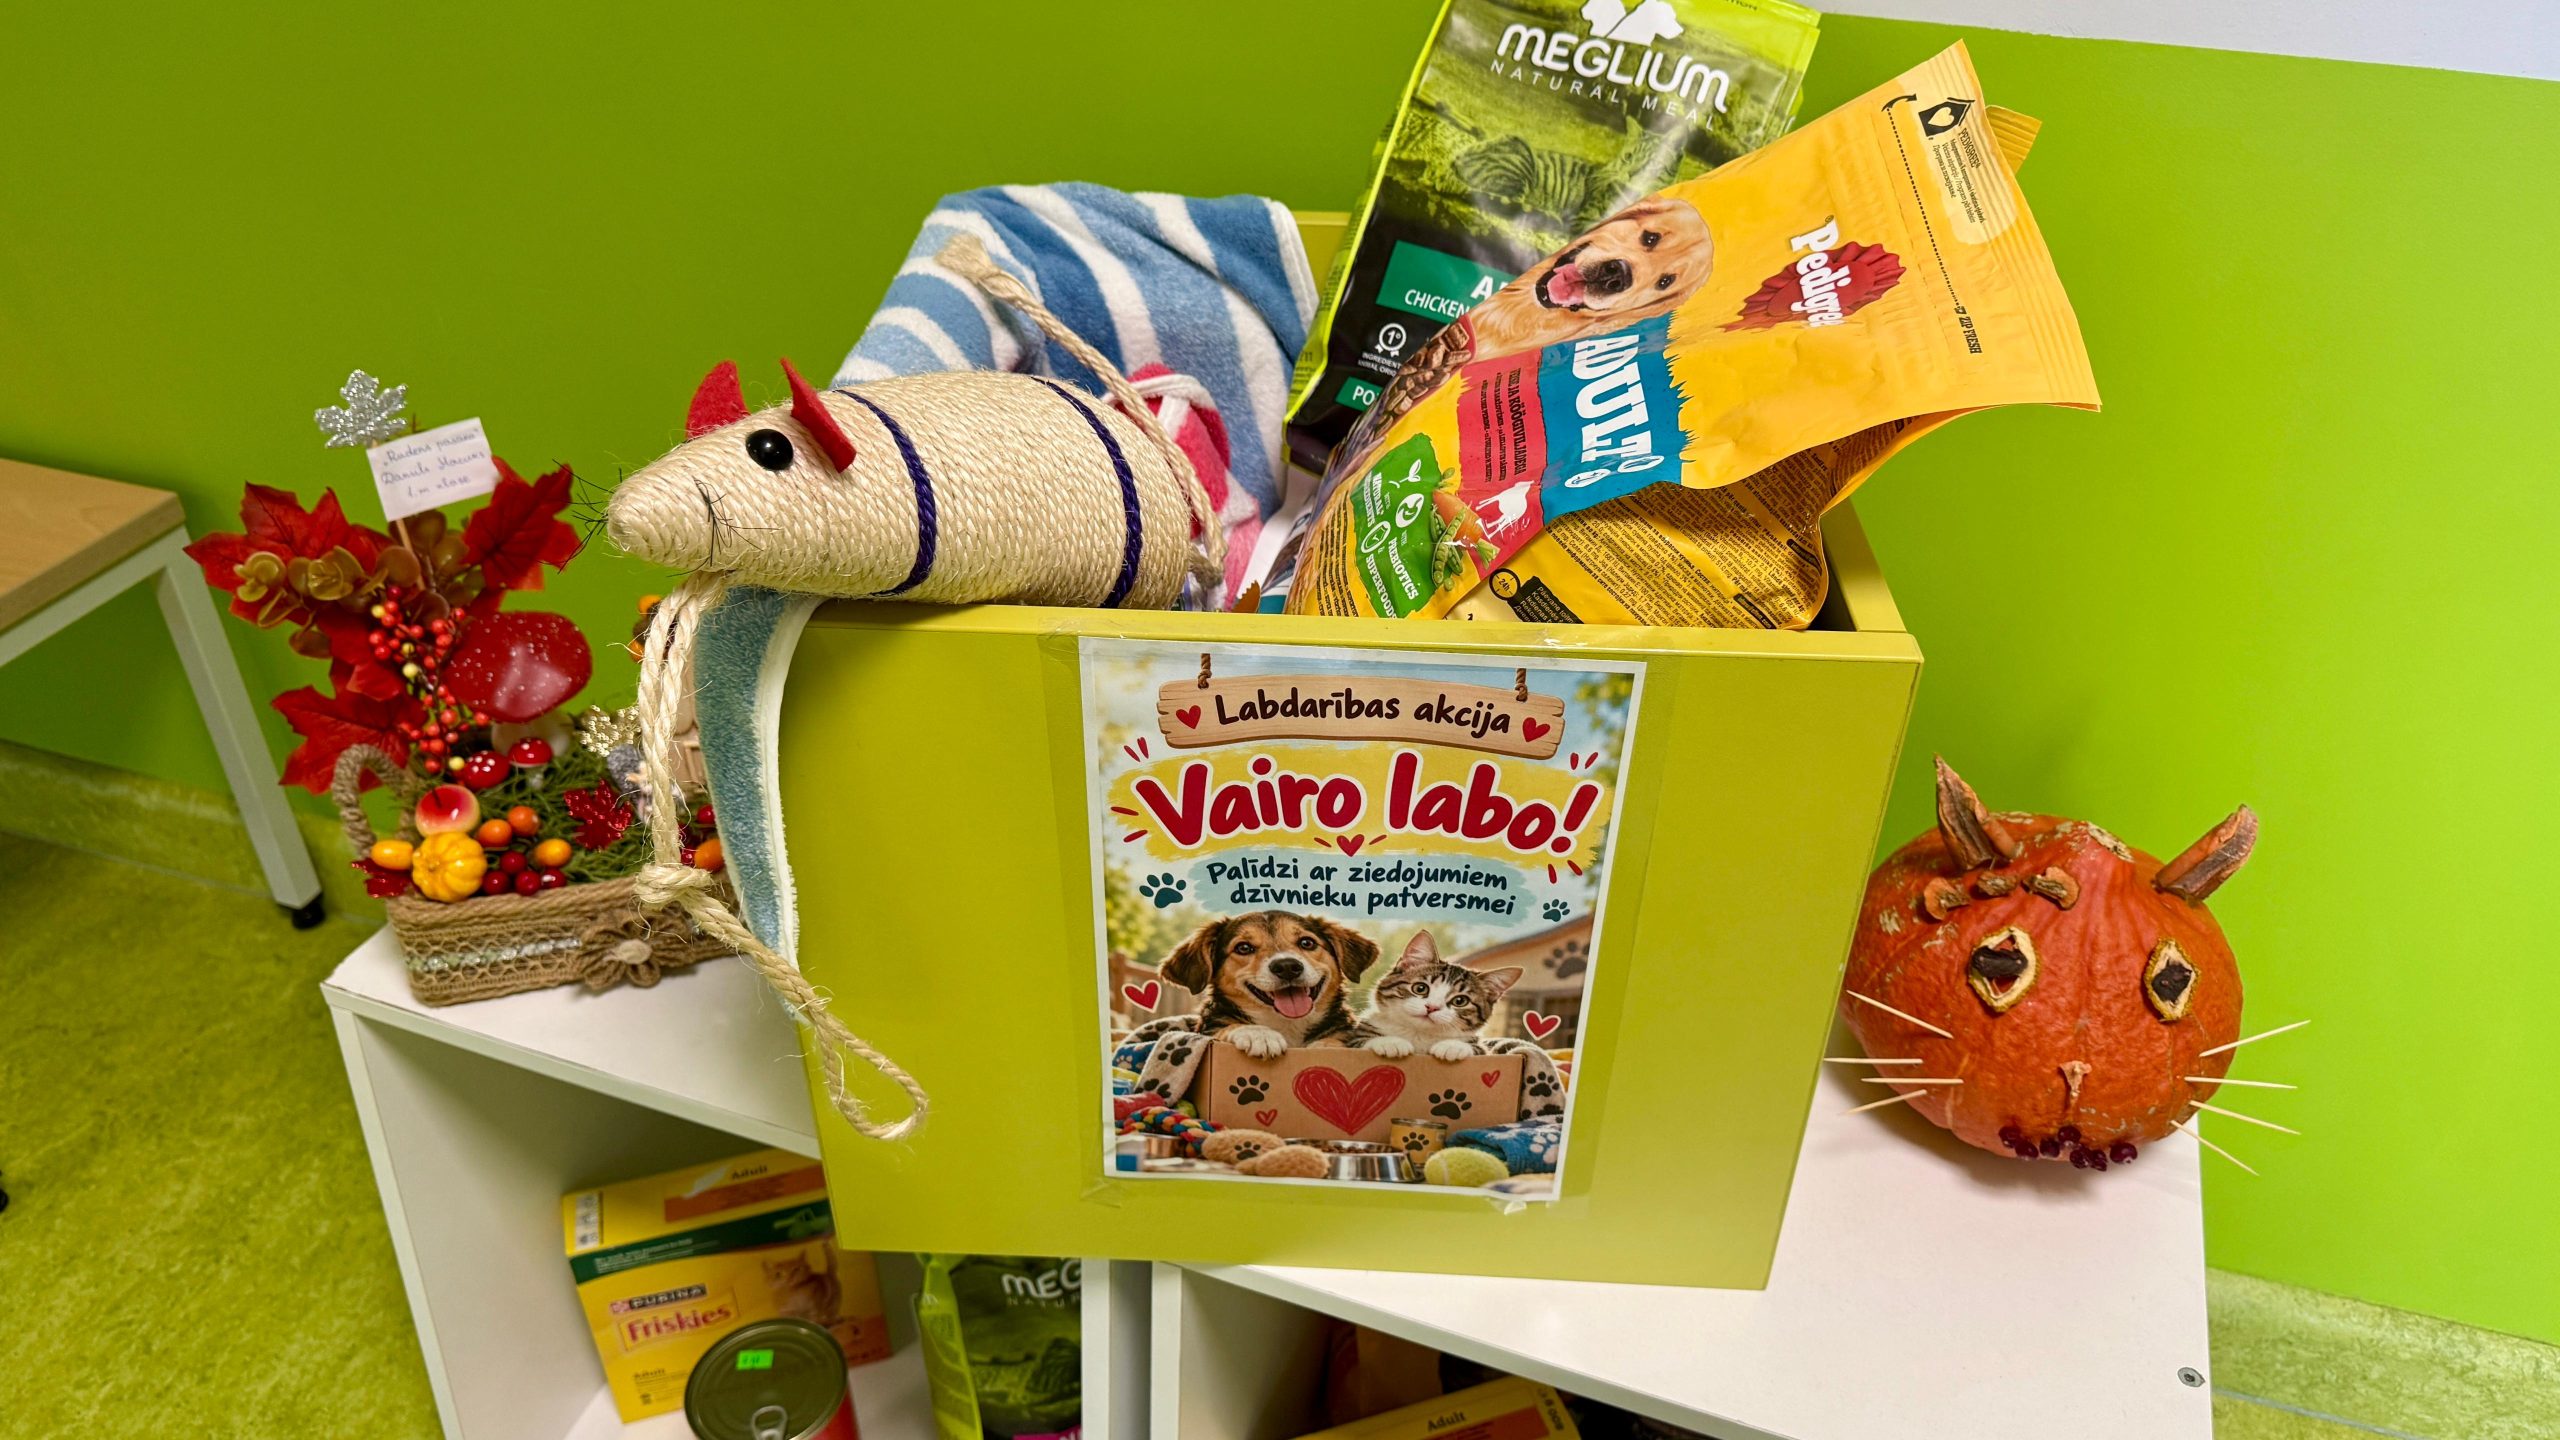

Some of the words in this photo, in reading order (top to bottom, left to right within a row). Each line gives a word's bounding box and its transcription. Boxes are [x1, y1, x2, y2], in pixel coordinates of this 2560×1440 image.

[1497, 24, 1728, 113] MEGLIUM
[1490, 59, 1620, 104] NATURAL
[1642, 97, 1714, 131] MEAL
[1404, 289, 1470, 319] CHICKEN
[1471, 275, 1509, 299] A
[1959, 316, 1973, 327] ZIP
[1963, 328, 1982, 353] FRESH
[1352, 385, 1379, 406] PO
[1507, 385, 1519, 397] JA
[1572, 333, 1652, 464] ADULT
[1507, 396, 1527, 475] KÖÖGIVILJADEGA
[1387, 536, 1418, 600] PREBIOTICS
[1498, 577, 1510, 591] 24h
[1215, 688, 1400, 726] Labdarības
[1413, 693, 1511, 738] akcija
[1135, 757, 1361, 846] Vairo
[1389, 751, 1598, 853] labo!
[1206, 855, 1299, 885] Palīdzi
[1309, 865, 1333, 882] ar
[1348, 861, 1508, 891] ziedojumiem
[1229, 881, 1356, 908] dzīvnieku
[1367, 887, 1516, 919] patversmei
[628, 1305, 731, 1343] Friskies
[1427, 1411, 1466, 1432] Adult
